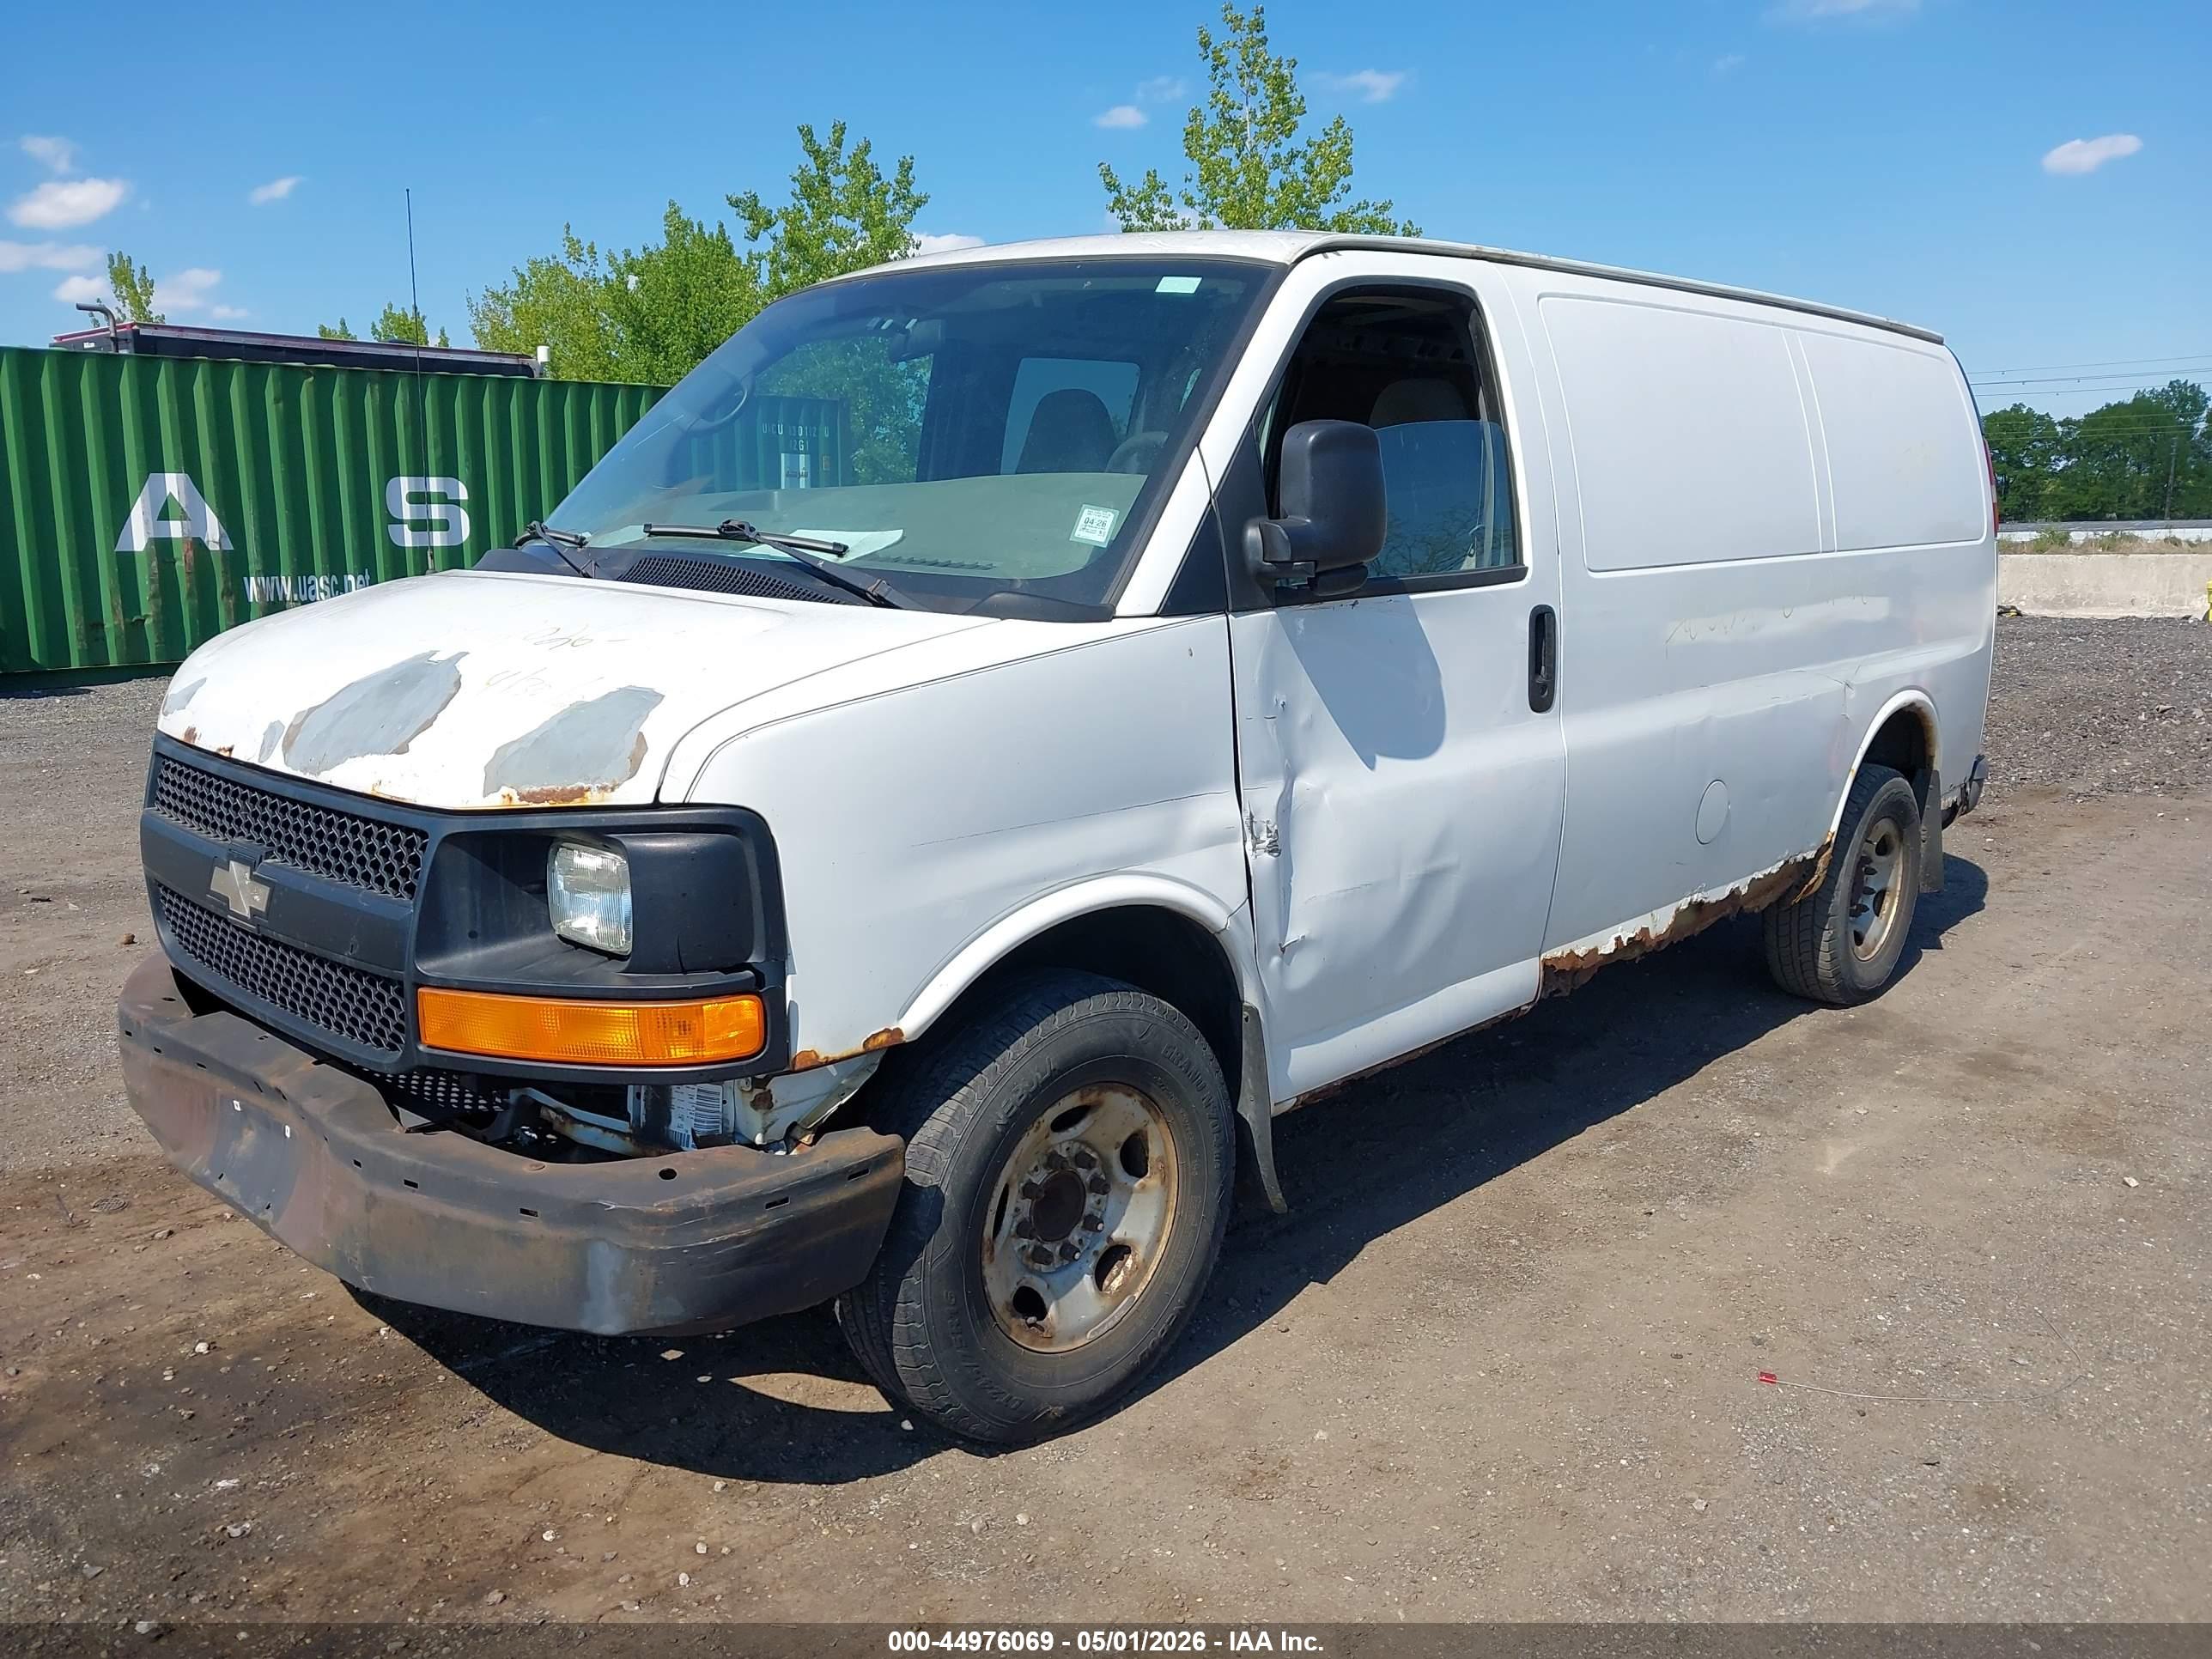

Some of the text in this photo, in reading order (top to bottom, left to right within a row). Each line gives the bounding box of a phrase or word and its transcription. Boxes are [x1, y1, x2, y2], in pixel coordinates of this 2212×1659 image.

[114, 473, 471, 552] A S
[243, 568, 372, 603] www.uasc.net
